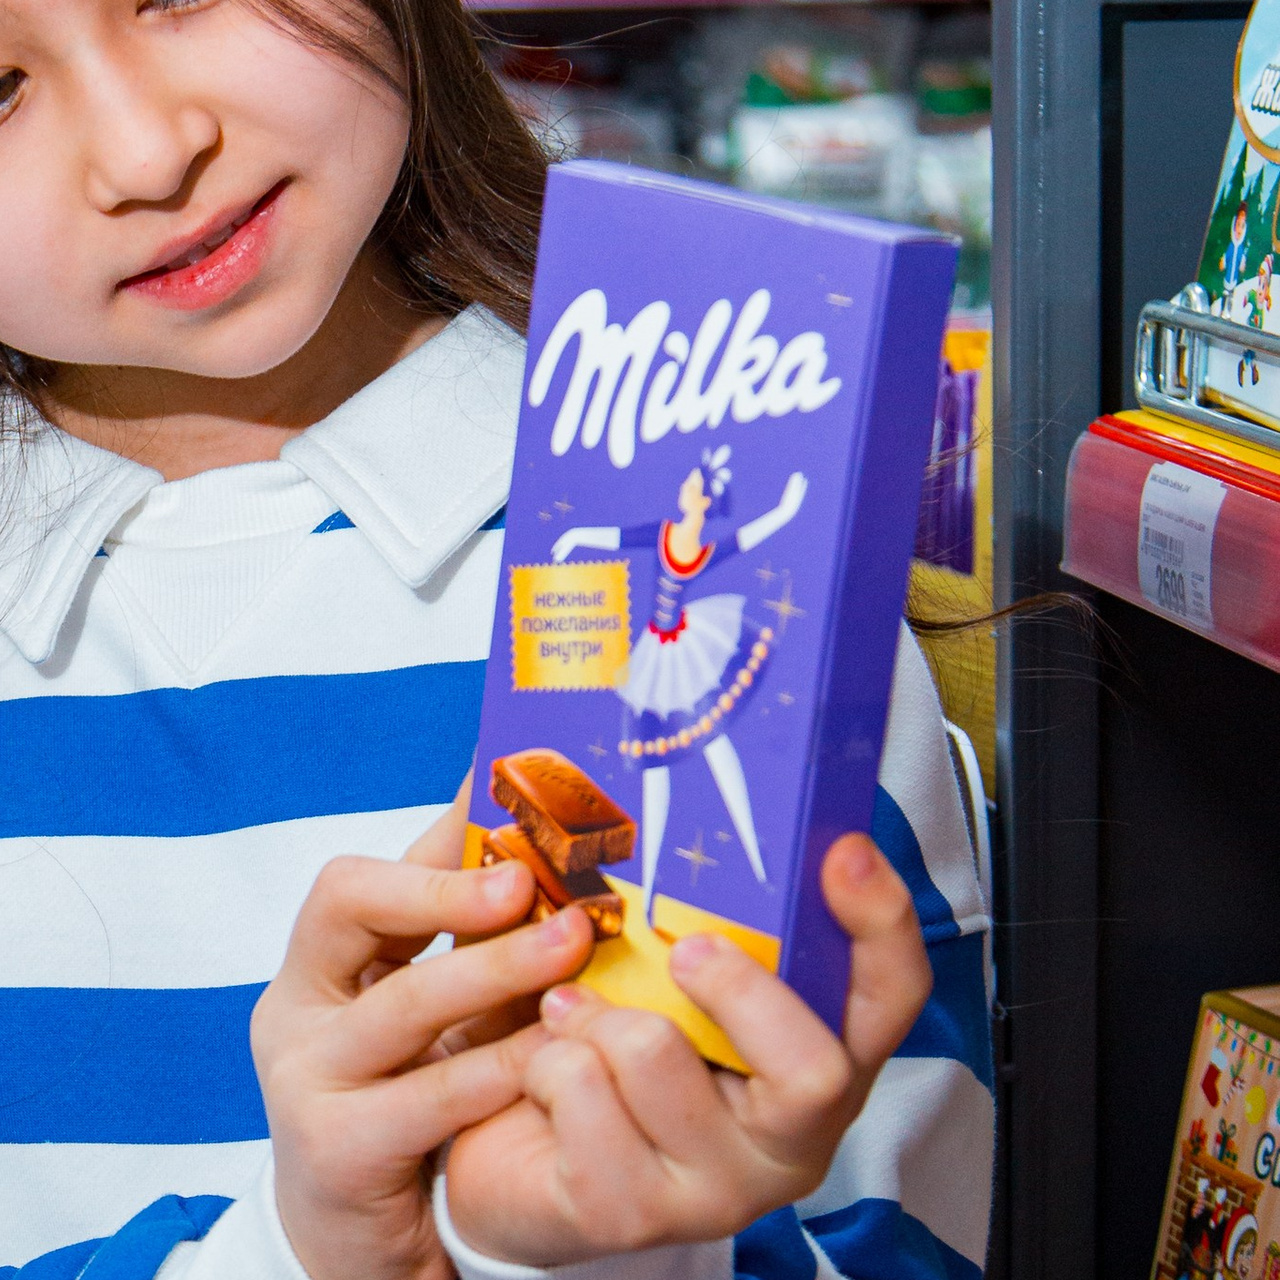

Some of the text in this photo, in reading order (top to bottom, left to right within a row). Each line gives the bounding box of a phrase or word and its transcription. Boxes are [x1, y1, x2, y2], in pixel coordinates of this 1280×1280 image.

[528, 288, 842, 469] Milka
[534, 590, 606, 609] нежные
[521, 614, 621, 634] пожелания
[540, 640, 603, 664] внутри
